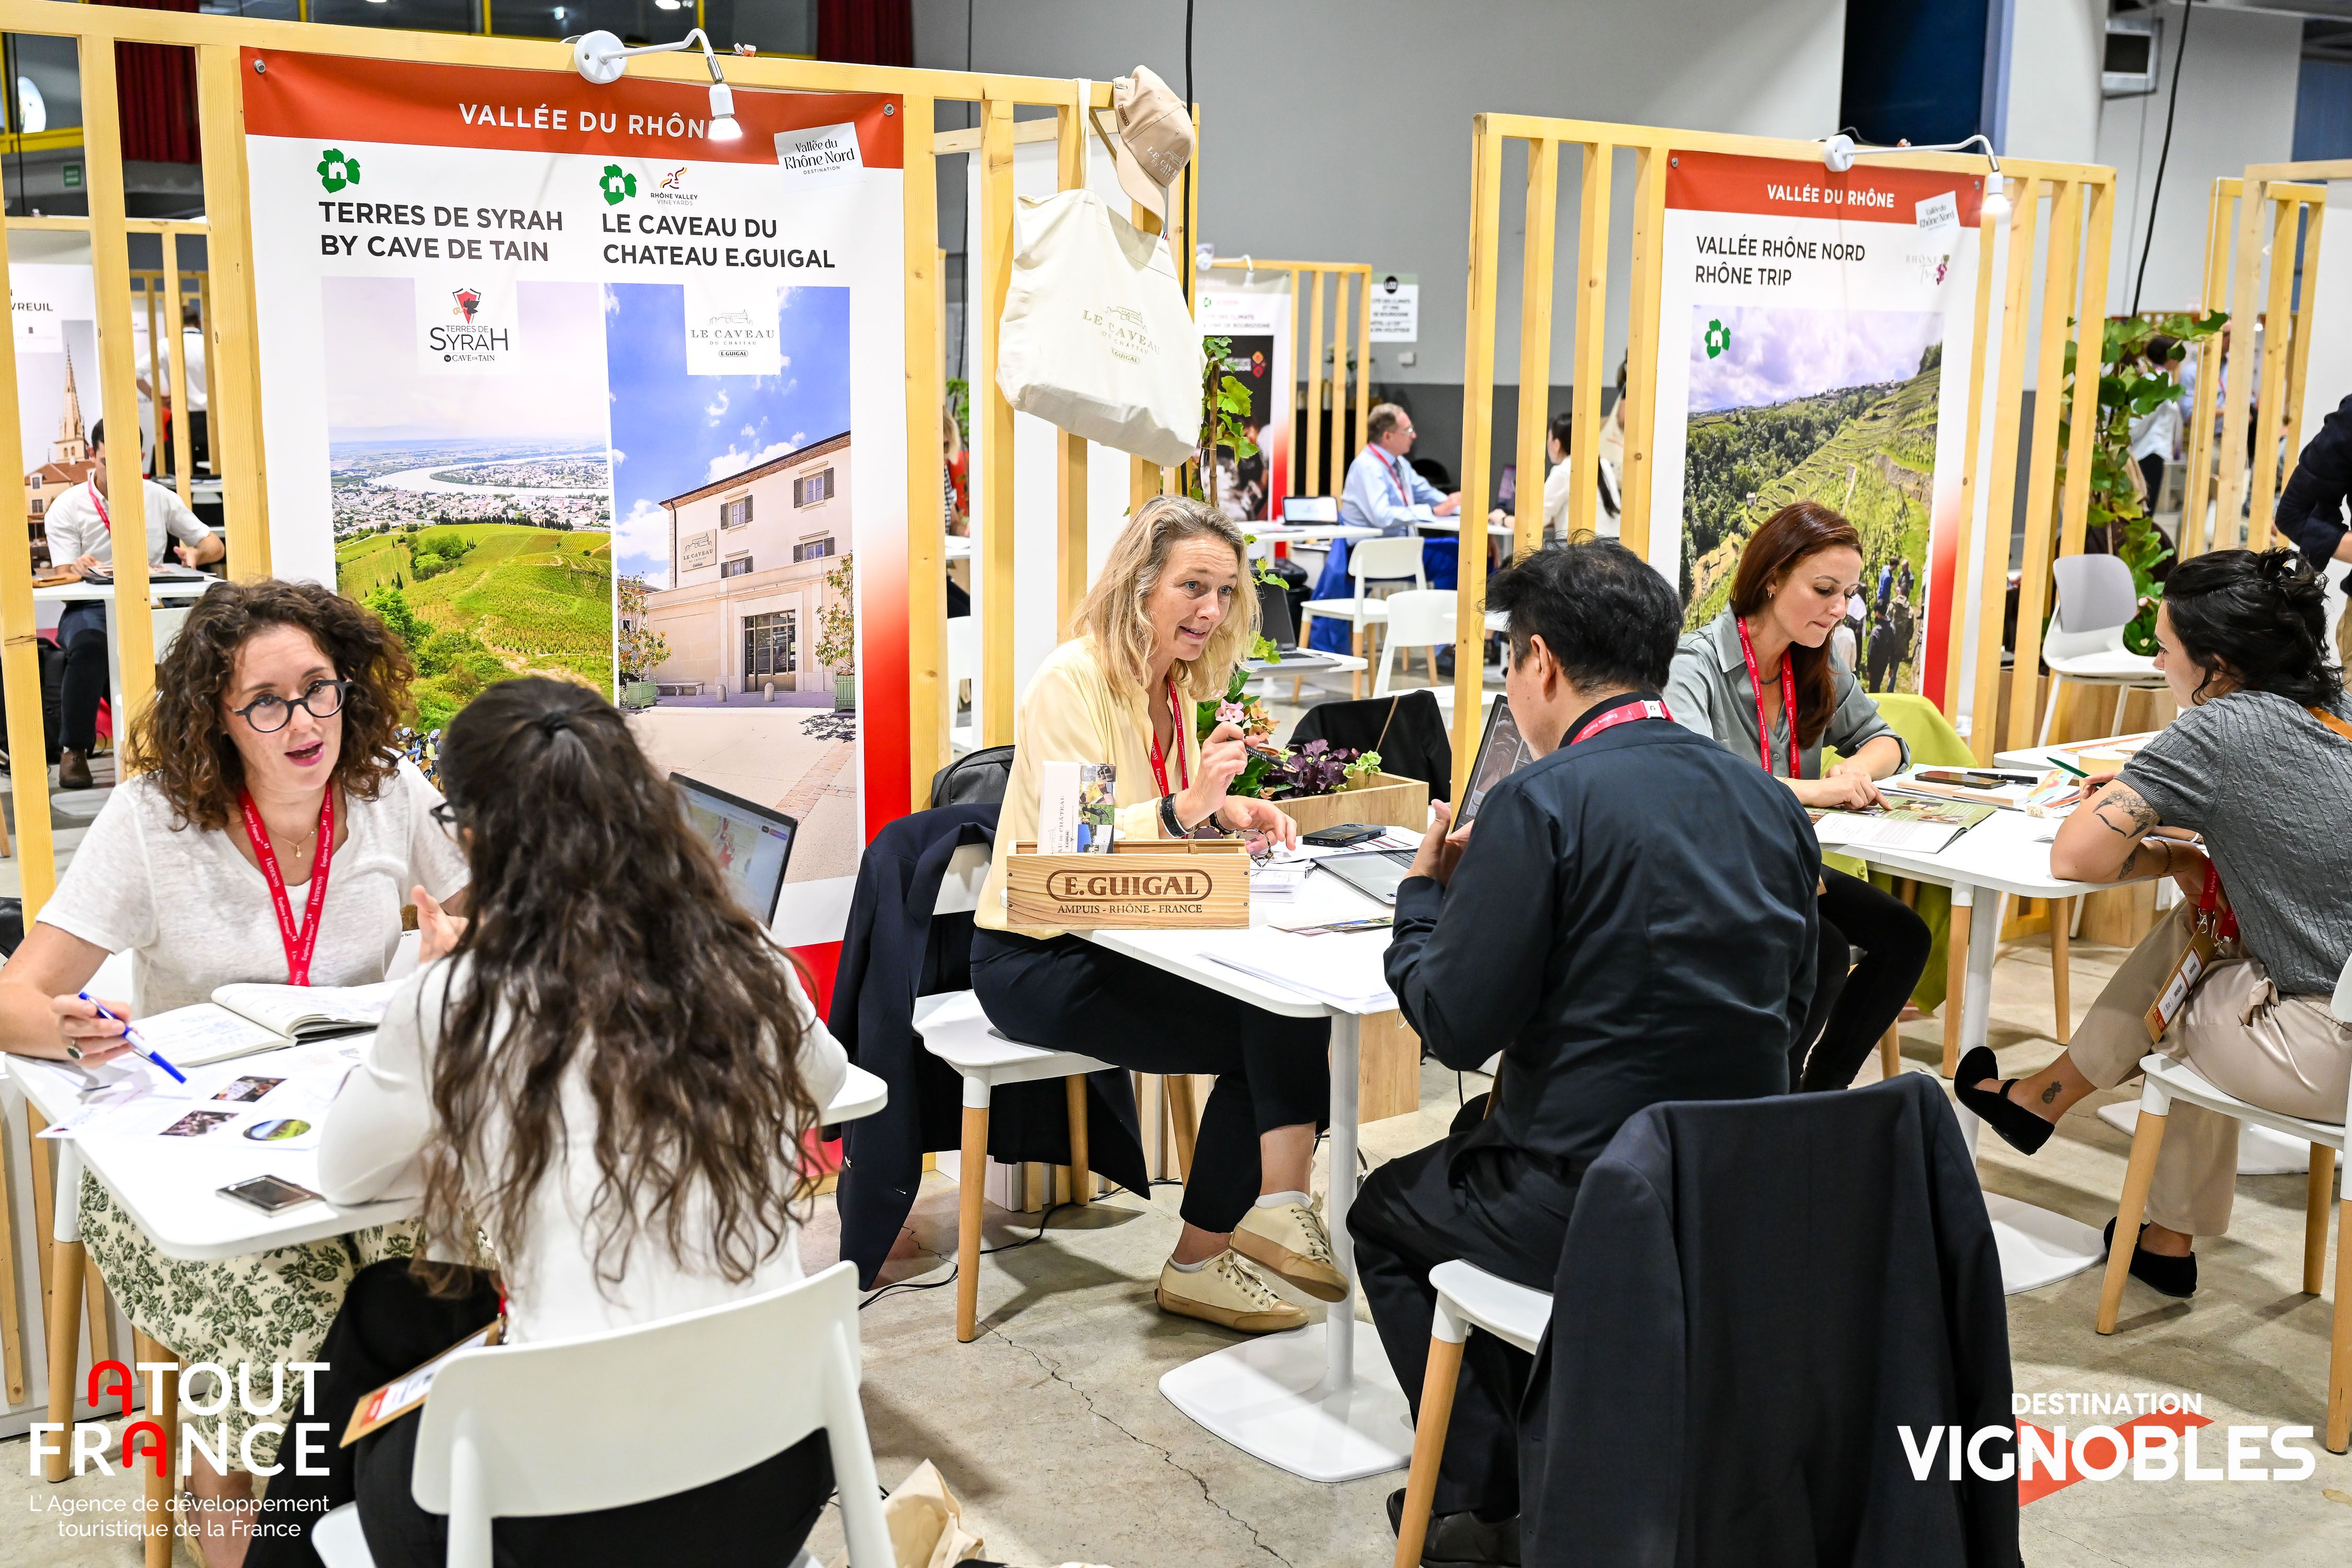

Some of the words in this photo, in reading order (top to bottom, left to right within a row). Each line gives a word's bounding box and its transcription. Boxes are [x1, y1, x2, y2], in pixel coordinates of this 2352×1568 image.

[459, 103, 567, 130] VALLÉE
[580, 111, 616, 133] DU
[629, 112, 713, 139] RHÔN
[825, 139, 838, 149] du
[784, 155, 823, 169] Rhône
[825, 148, 855, 164] Nord
[803, 166, 840, 175] DESTINATION
[1147, 146, 1159, 159] LE
[1160, 160, 1179, 176] CAVE
[1767, 183, 1819, 203] VALLÉE
[1824, 188, 1843, 204] DU
[1848, 188, 1894, 208] RHÔNE
[319, 202, 425, 225] TERRES
[434, 206, 469, 227] DE
[477, 208, 563, 230] SYRAH
[602, 213, 630, 234] LE
[639, 215, 736, 237] CAVEAU
[745, 219, 777, 238] DU
[321, 235, 358, 255] BY
[367, 236, 439, 258] CAVE
[448, 239, 482, 260] DE
[490, 240, 548, 261] TAIN
[604, 244, 717, 267] CHATEAU
[725, 248, 835, 268] E.GUIGAL
[1697, 234, 1757, 256] VALLÉE
[1762, 236, 1817, 259] RHÔNE
[1822, 243, 1865, 261] NORD
[1696, 262, 1752, 284] RHÔNE
[1758, 268, 1792, 286] TRIP
[430, 327, 508, 351] SYRAH
[691, 330, 708, 338] LE
[714, 330, 774, 338] CAVEAU
[1082, 309, 1103, 326] LE
[1109, 322, 1160, 355] CAVEAU
[1102, 331, 1112, 339] DU
[691, 549, 713, 558] CAVEAU
[311, 876, 325, 905] Hennessy
[1064, 876, 1198, 895] E.GUIGAL
[1057, 905, 1100, 913] AMPUIS
[1109, 903, 1150, 913] RHÔNE
[1159, 904, 1202, 913] FRANCE
